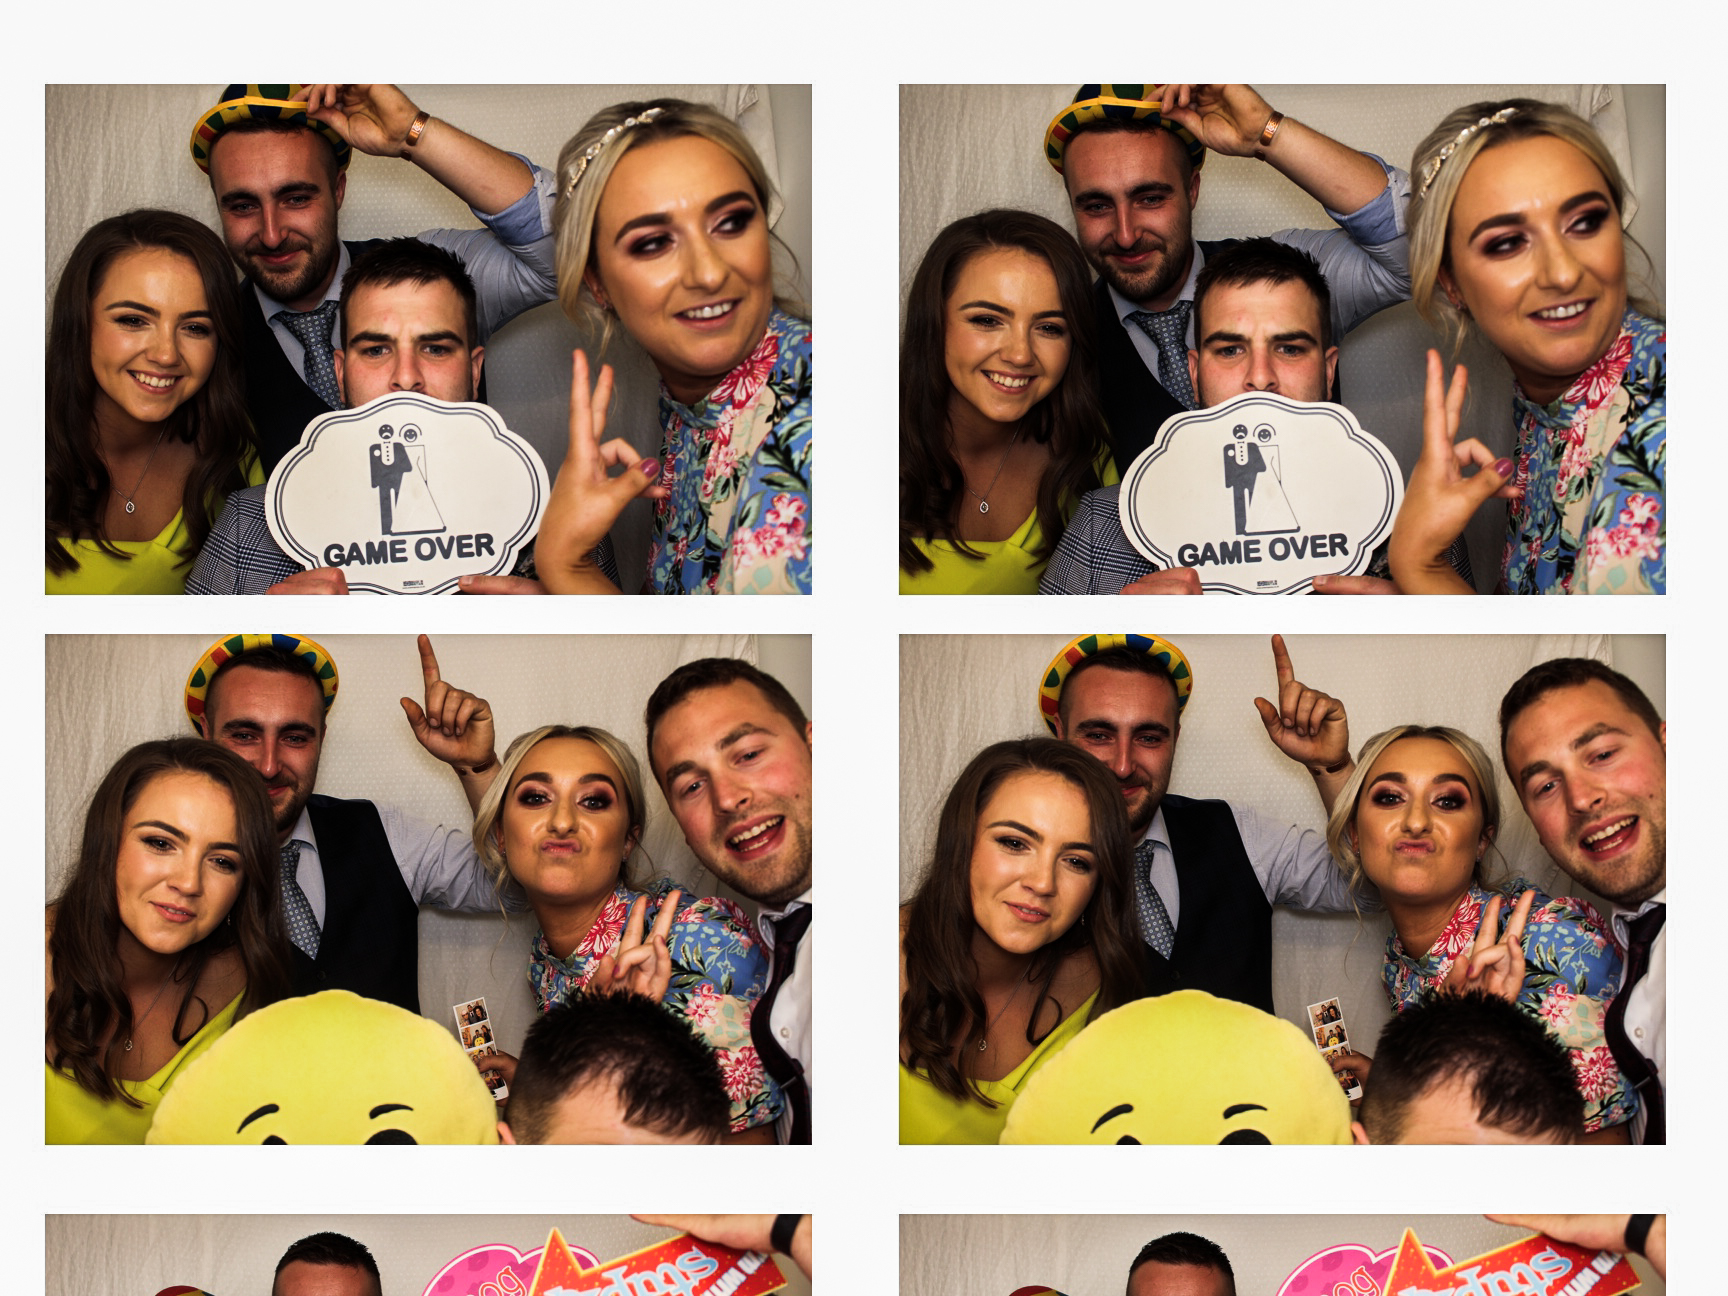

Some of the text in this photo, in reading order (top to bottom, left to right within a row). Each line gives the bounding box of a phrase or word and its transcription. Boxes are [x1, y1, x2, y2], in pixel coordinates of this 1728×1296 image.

[323, 533, 496, 567] GAME OVER
[1177, 533, 1350, 567] GAME OVER
